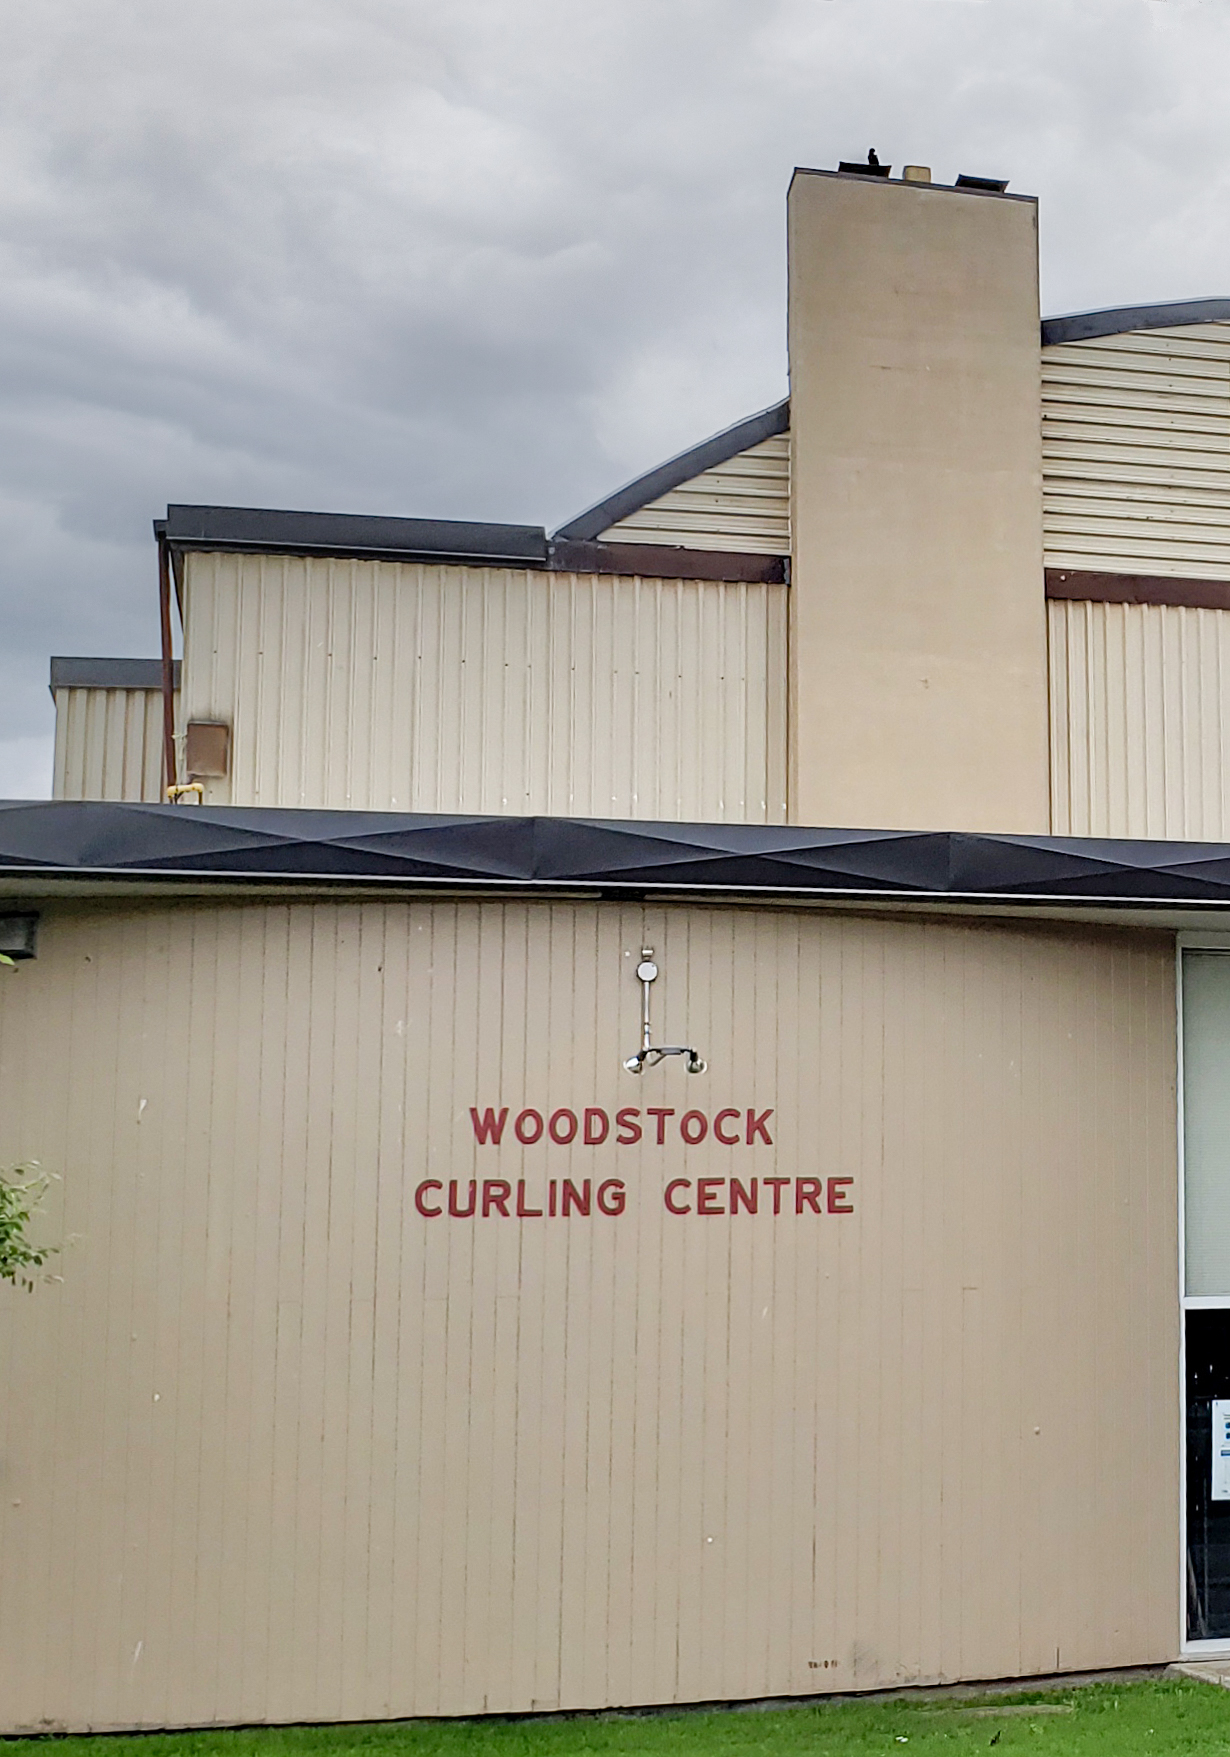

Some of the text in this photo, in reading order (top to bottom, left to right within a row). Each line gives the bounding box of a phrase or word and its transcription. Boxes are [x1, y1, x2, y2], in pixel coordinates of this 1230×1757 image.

[469, 1106, 774, 1145] WOODSTOCK
[414, 1176, 855, 1218] CURLING CENTRE
